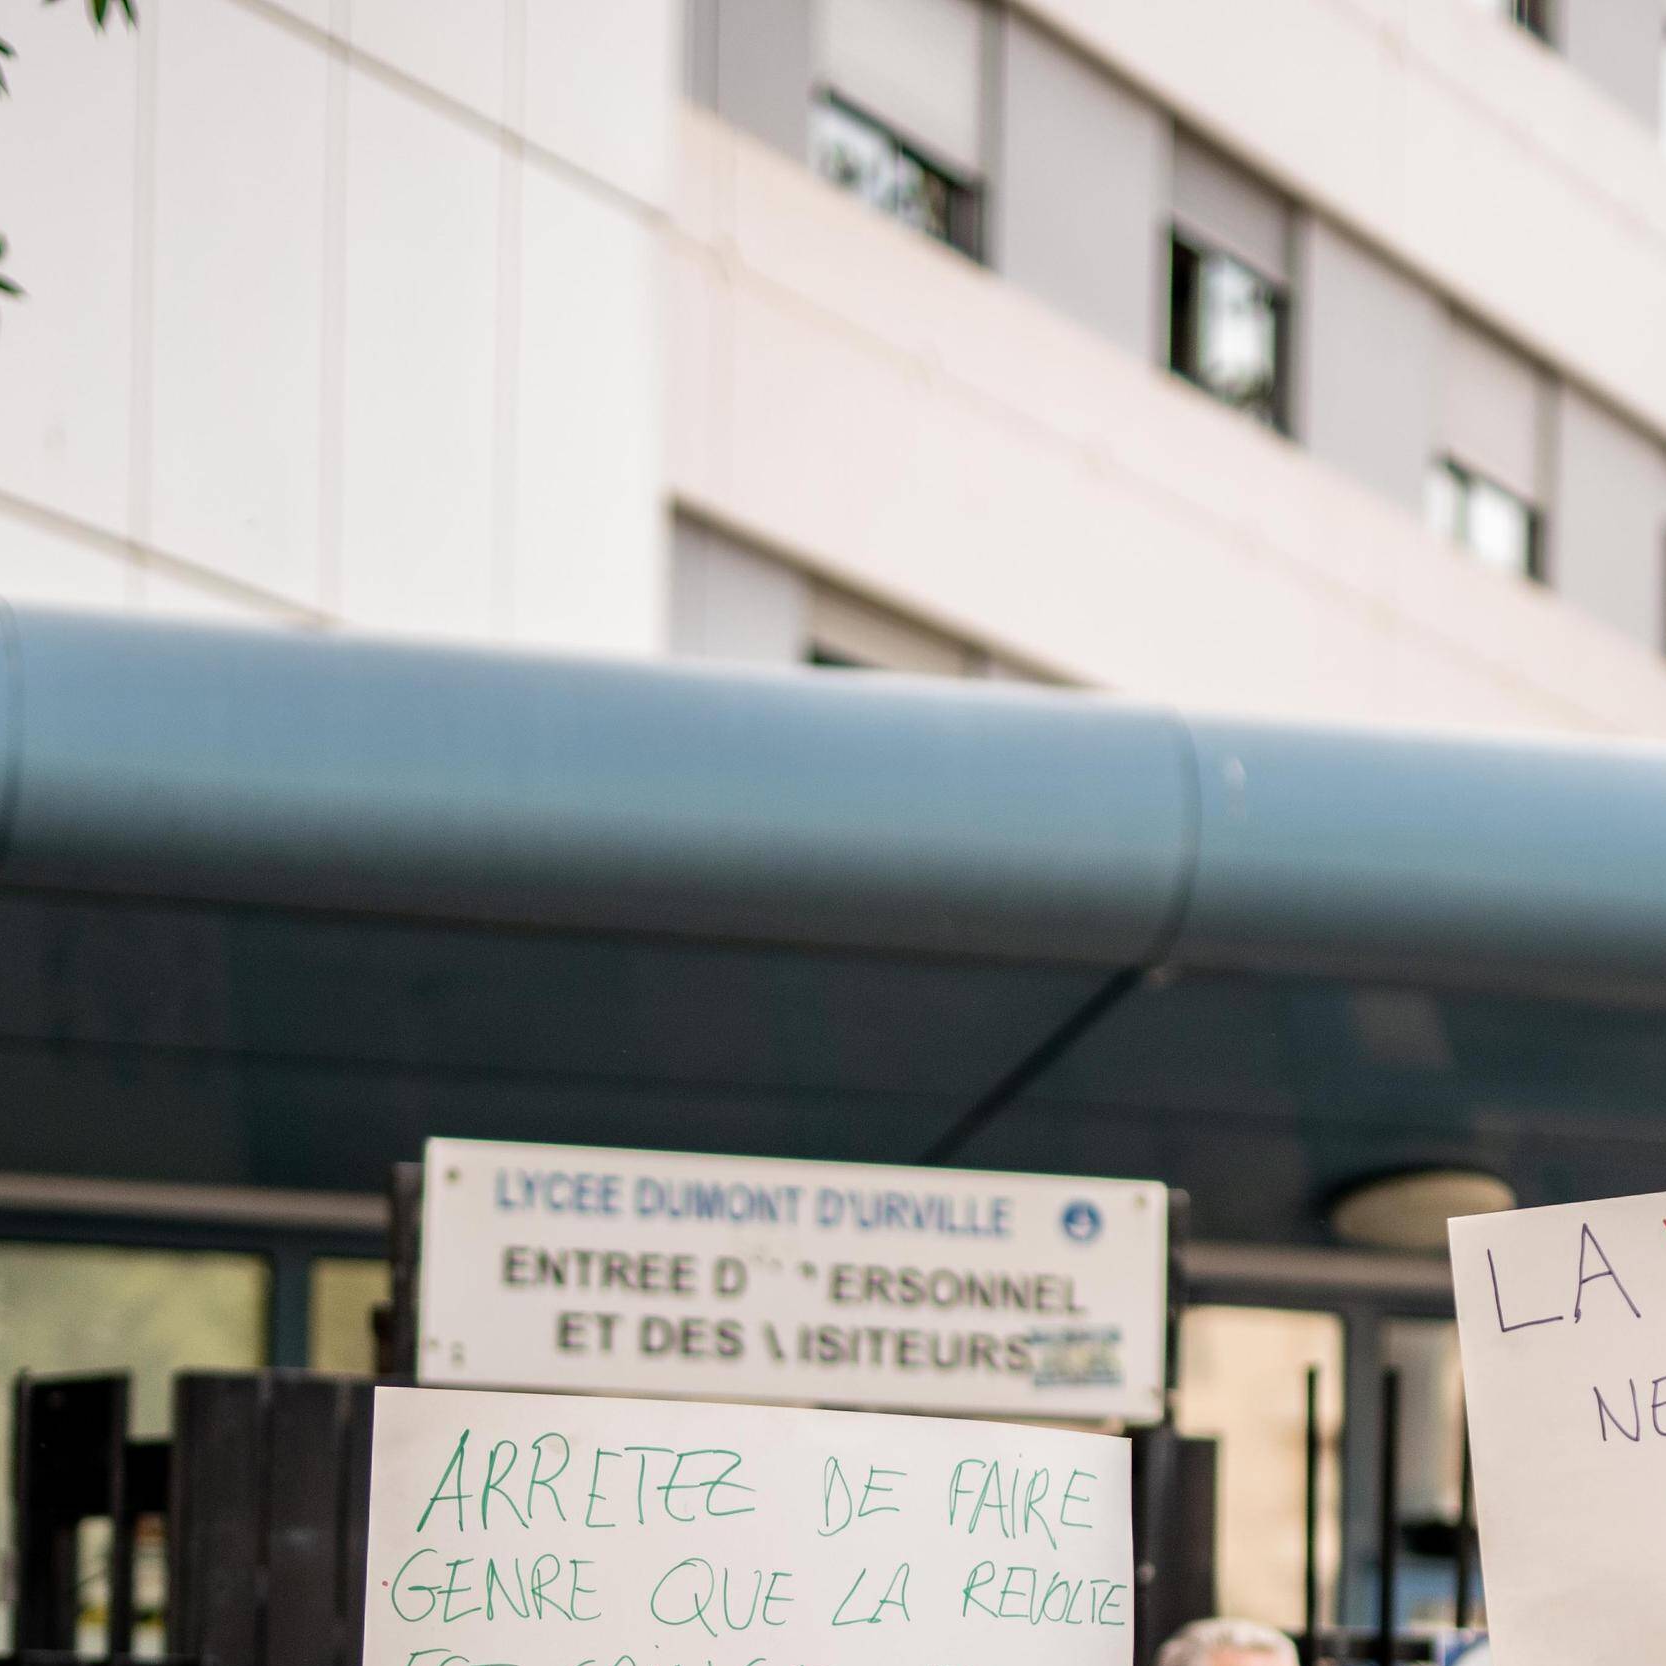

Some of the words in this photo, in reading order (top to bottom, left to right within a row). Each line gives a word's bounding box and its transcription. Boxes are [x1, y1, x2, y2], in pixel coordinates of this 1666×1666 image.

[494, 1168, 621, 1215] LYCEE
[636, 1175, 799, 1228] DUMONT
[816, 1184, 1014, 1240] D'URVILLE
[500, 1245, 707, 1298] ENTREE
[795, 1261, 1090, 1316] ERSONNEL
[1486, 1222, 1642, 1333] LA
[555, 1311, 622, 1354] ET
[638, 1315, 745, 1359] DES
[415, 1427, 758, 1533] ARRETEZ
[815, 1454, 909, 1537] DE
[390, 1547, 603, 1624] GENRE
[649, 1556, 795, 1633] QUE
[831, 1561, 912, 1627] LA
[961, 1560, 1129, 1628] REVOLTE
